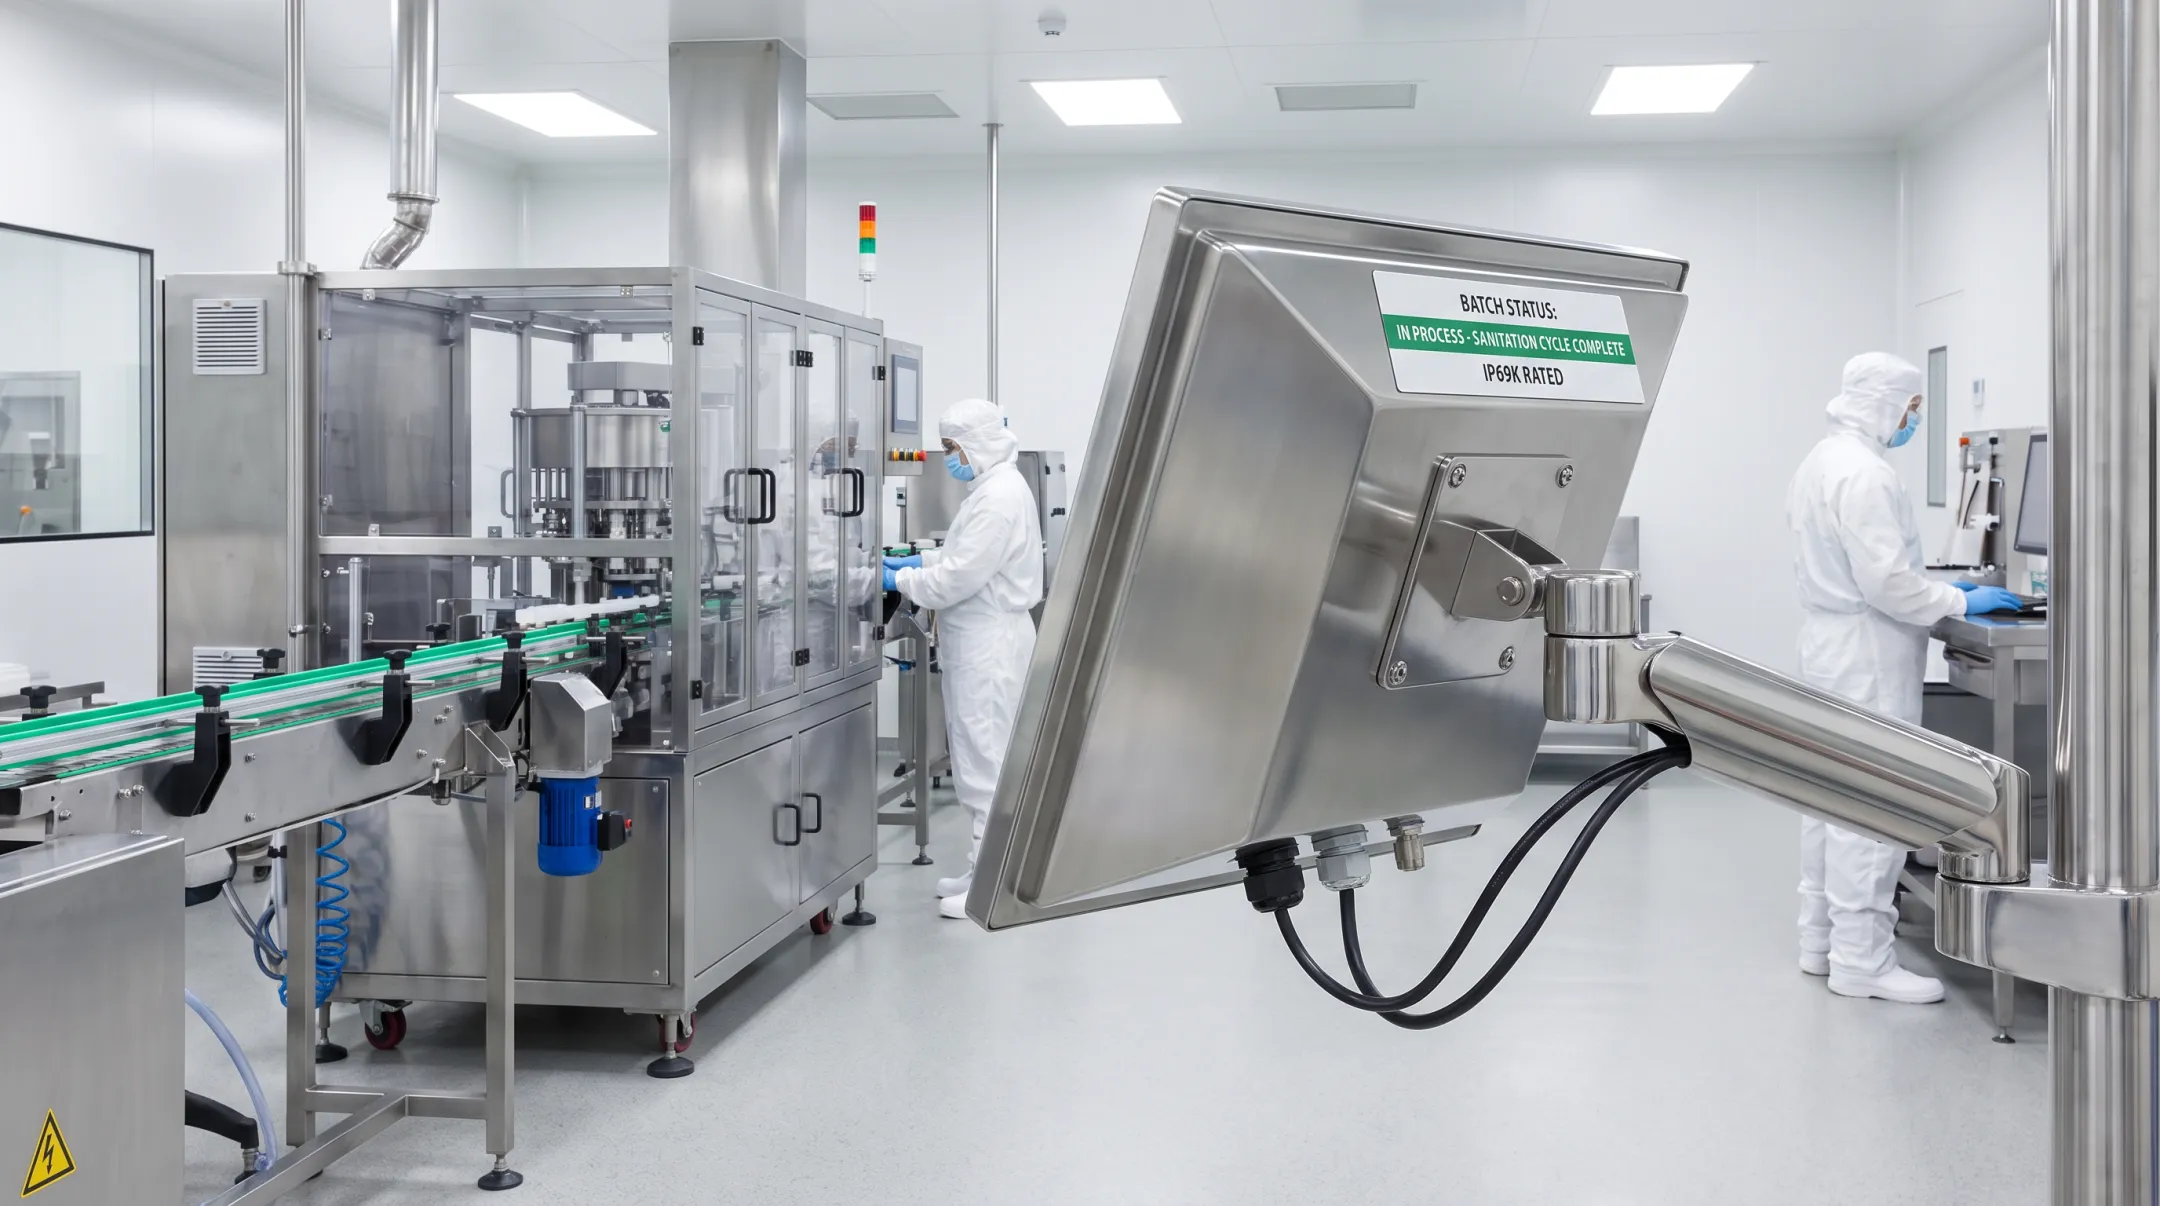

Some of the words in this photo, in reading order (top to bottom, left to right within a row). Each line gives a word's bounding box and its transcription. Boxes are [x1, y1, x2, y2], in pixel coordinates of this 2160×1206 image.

[1460, 294, 1505, 315] BATCH
[1506, 298, 1557, 320] STATUS:
[1396, 324, 1411, 341] IN
[1412, 325, 1465, 345] PROCESS
[1472, 330, 1538, 350] SANITATION
[1539, 335, 1572, 353] CYCLE
[1572, 338, 1626, 357] COMPLETE
[1482, 363, 1522, 384] IP69K
[1522, 366, 1564, 386] RATED
